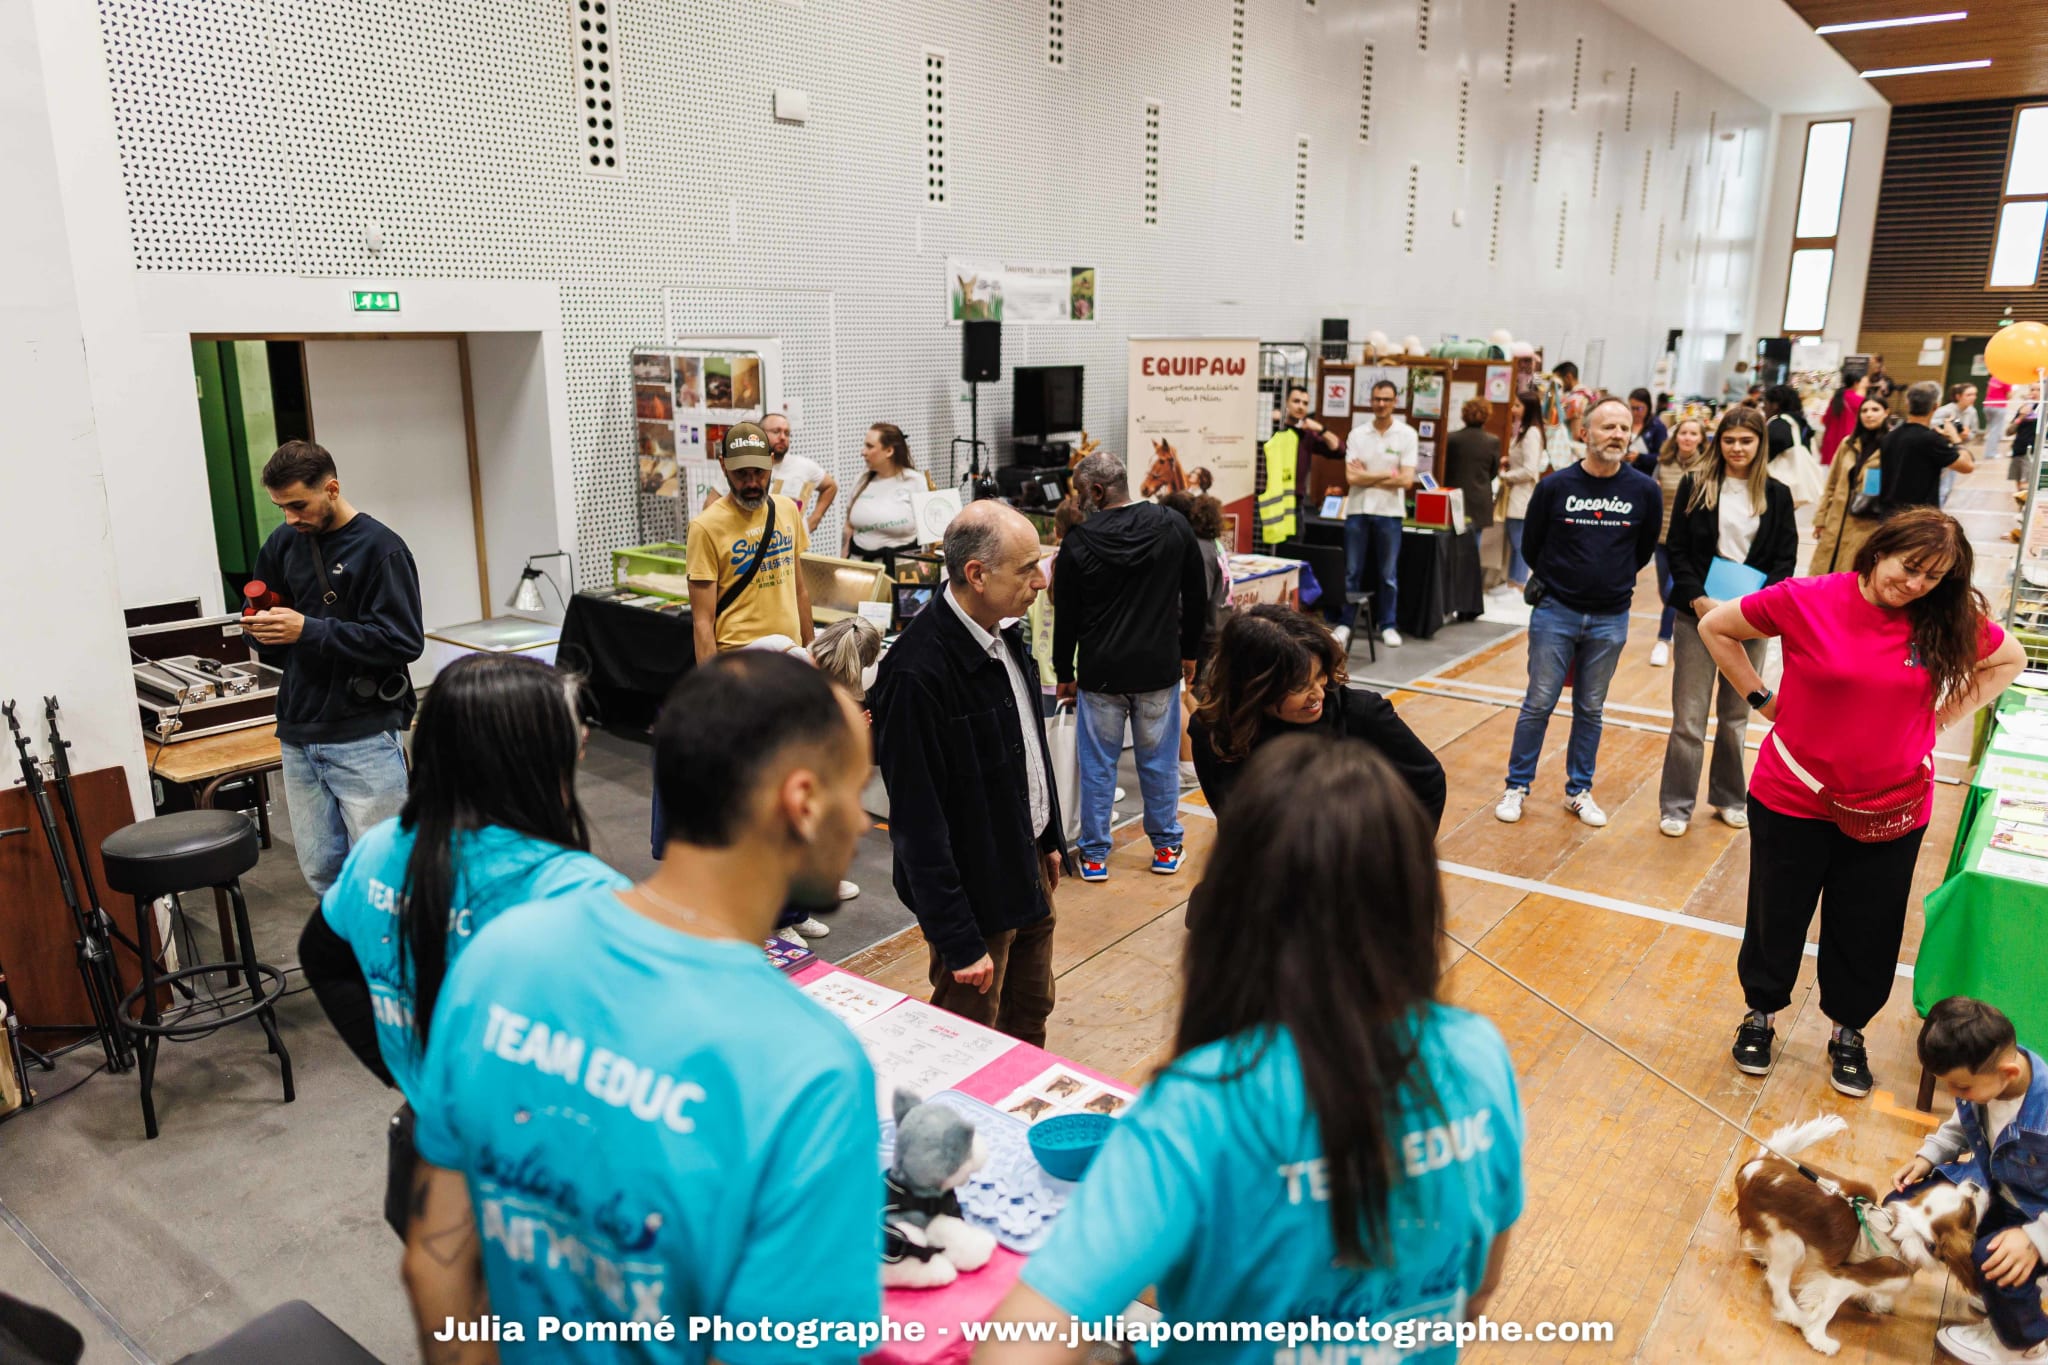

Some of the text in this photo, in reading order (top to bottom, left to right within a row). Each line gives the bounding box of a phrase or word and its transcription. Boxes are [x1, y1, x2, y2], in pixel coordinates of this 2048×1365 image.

[1142, 357, 1245, 376] EQUIPAW
[730, 437, 766, 449] ellesse
[1565, 495, 1633, 514] Cocorico
[483, 1003, 585, 1085] TEAM
[584, 1047, 706, 1134] EDUC
[1278, 1108, 1495, 1205] TE EDUC
